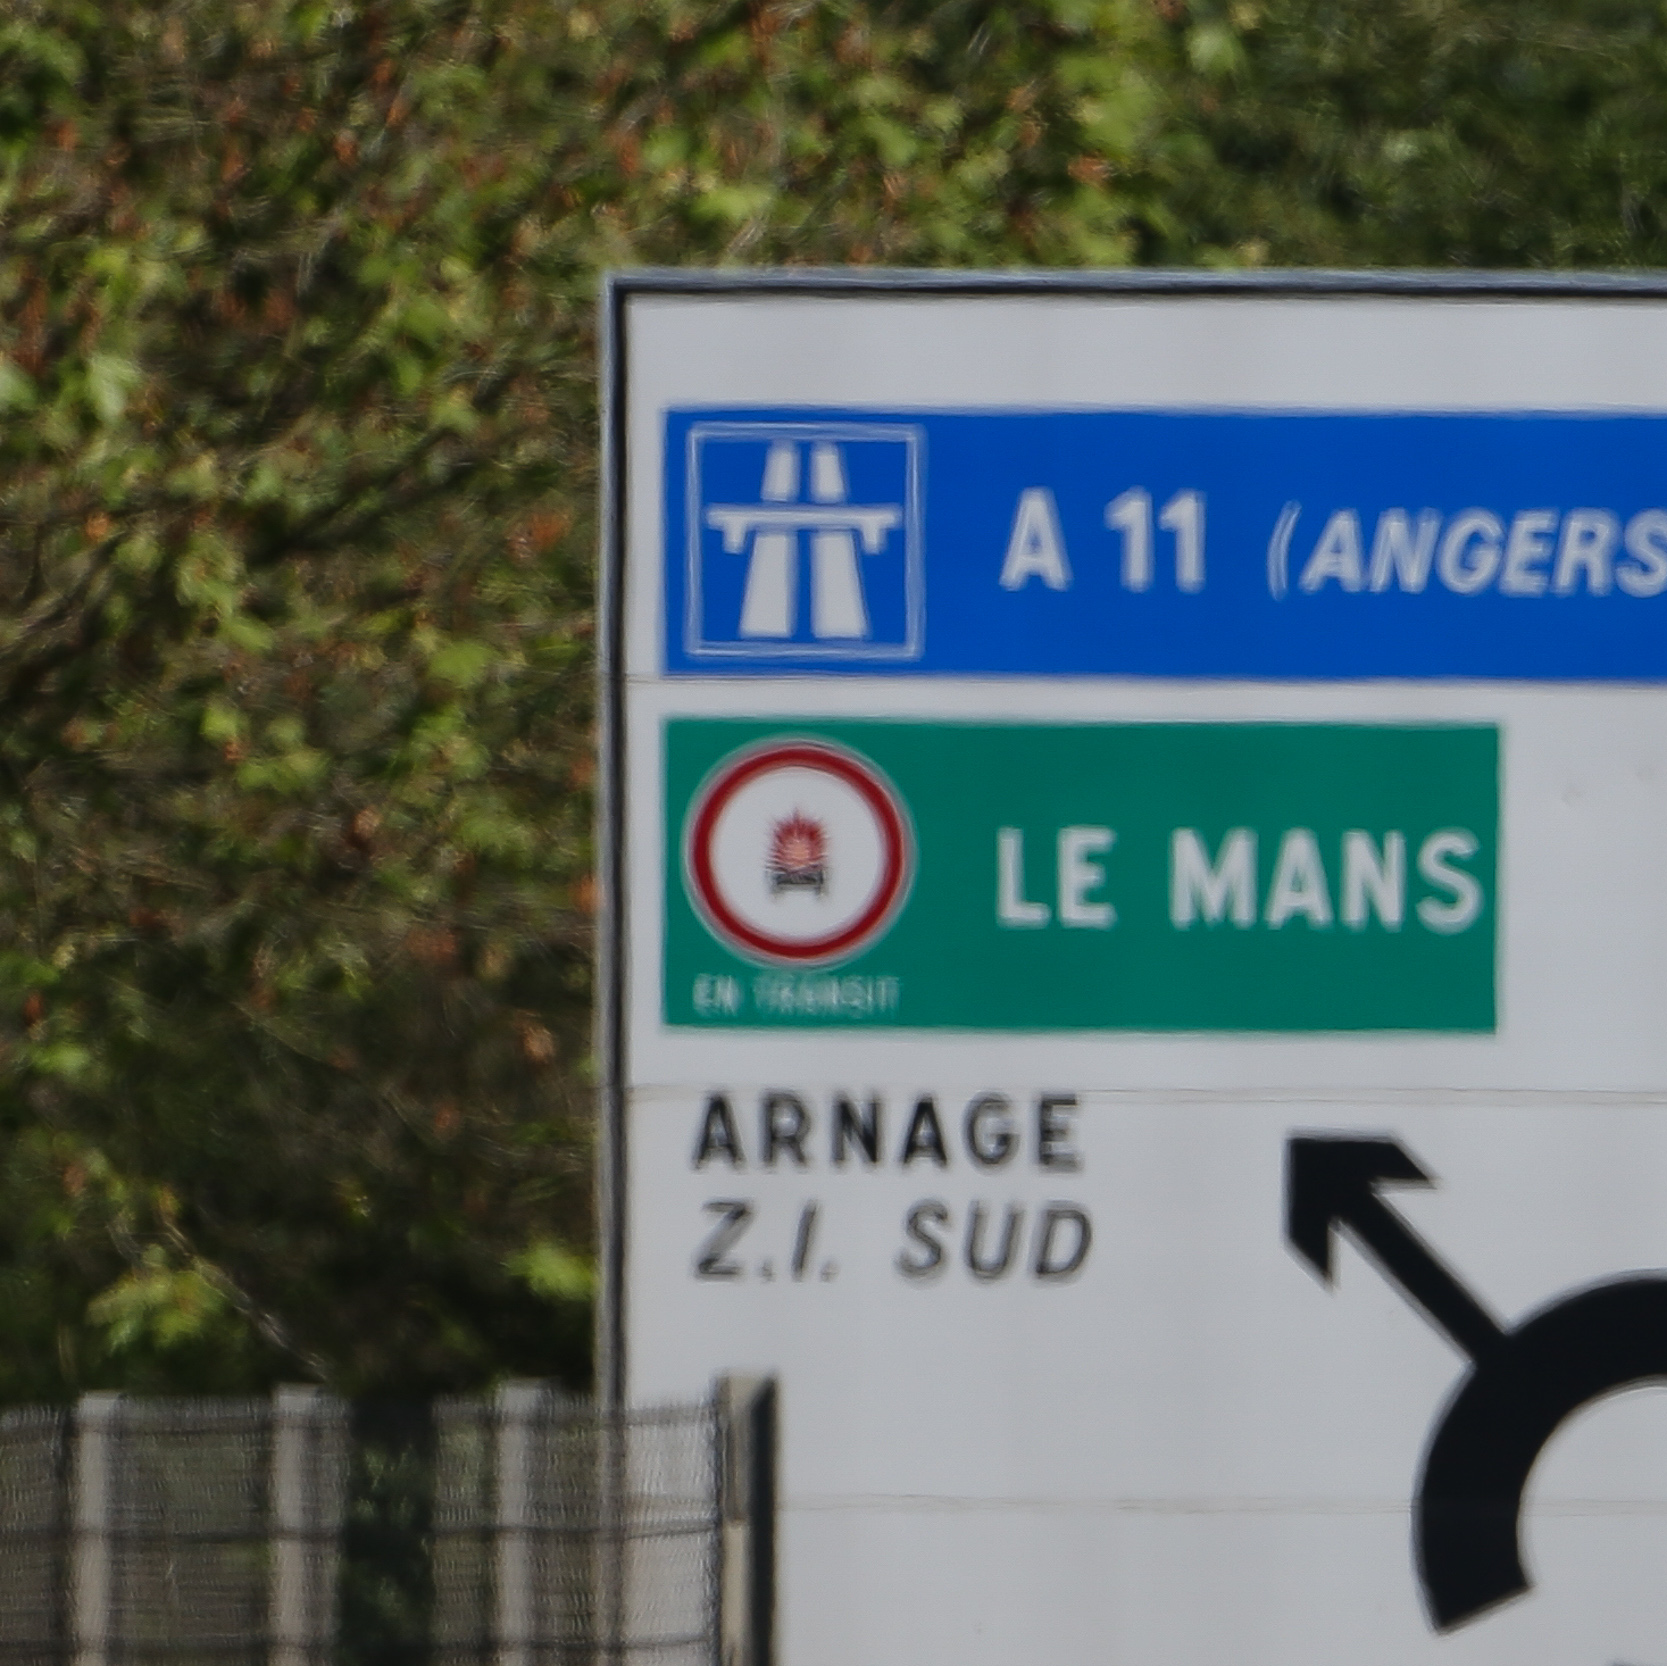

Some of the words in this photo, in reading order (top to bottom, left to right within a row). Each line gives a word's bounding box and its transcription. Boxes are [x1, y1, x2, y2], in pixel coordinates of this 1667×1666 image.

[1000, 486, 1072, 594] A
[1106, 486, 1207, 594] 11
[997, 825, 1117, 930] LE
[1169, 825, 1483, 935] MANS
[693, 1090, 1084, 1173] ARNAGE
[694, 1199, 838, 1282] Z.I.
[896, 1199, 1092, 1284] SUD
